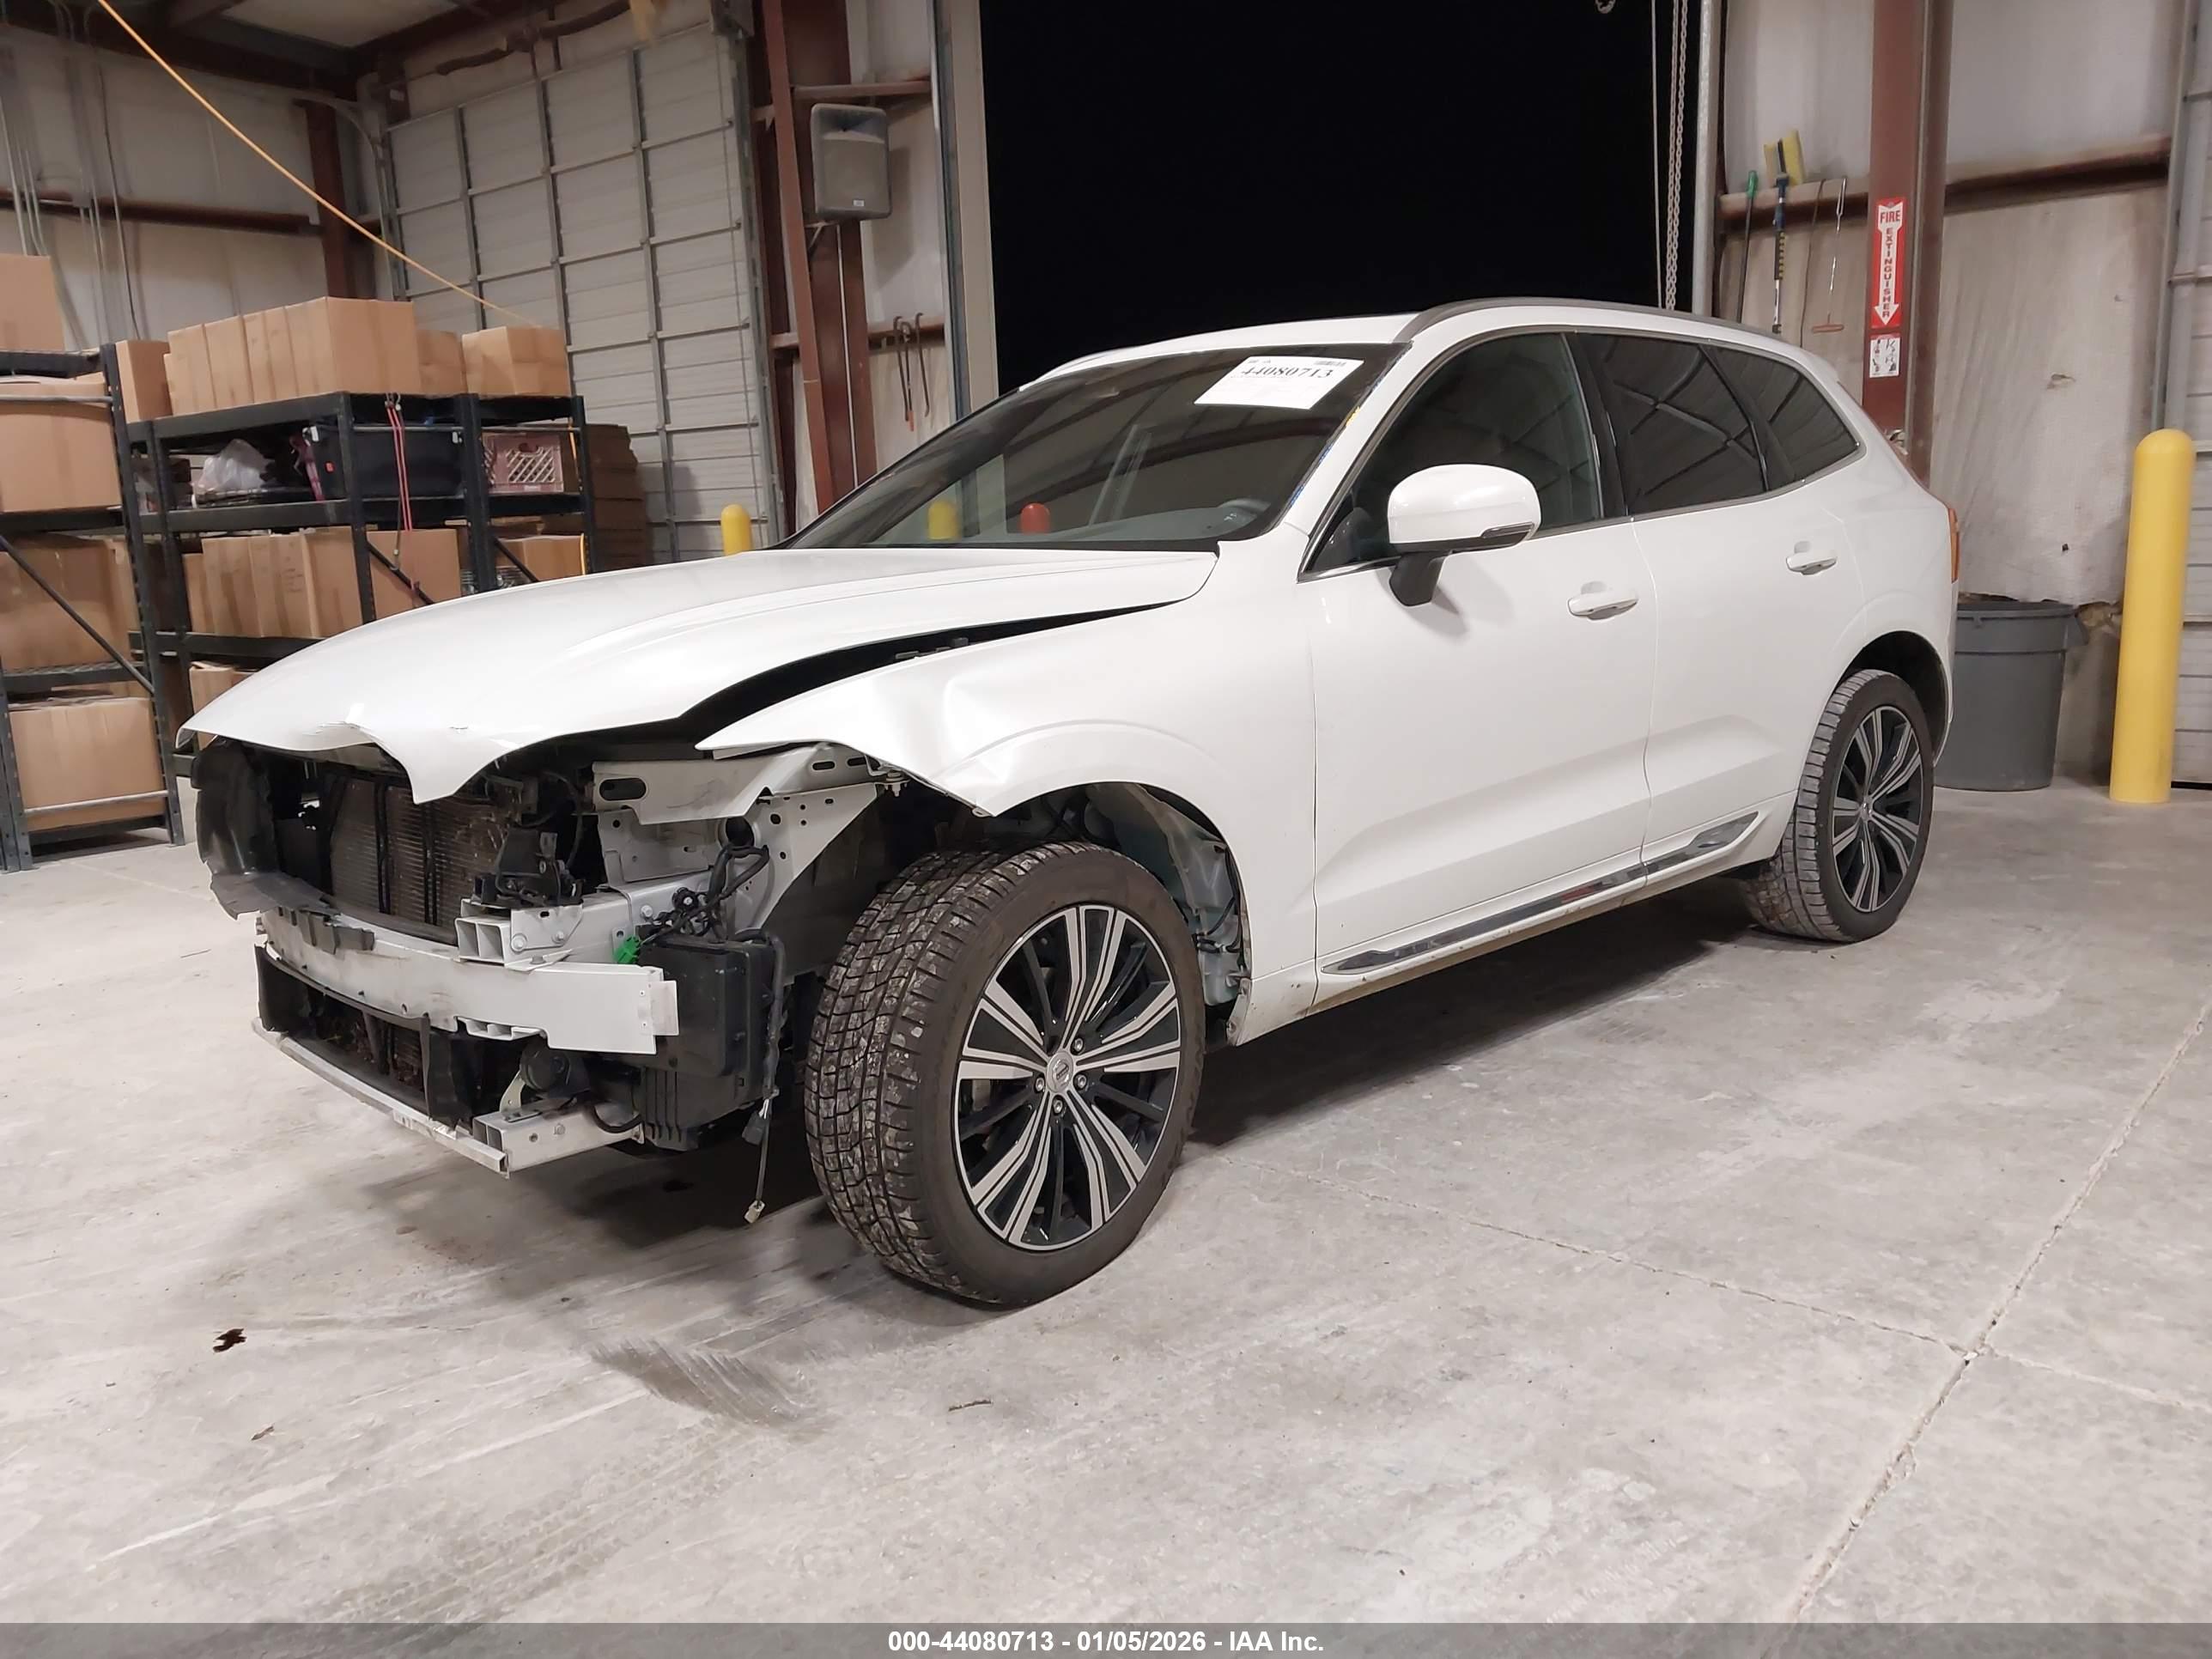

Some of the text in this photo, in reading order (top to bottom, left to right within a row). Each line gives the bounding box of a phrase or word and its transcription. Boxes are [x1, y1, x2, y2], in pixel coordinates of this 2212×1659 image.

[1880, 210, 1901, 223] FIRE
[1882, 228, 1893, 318] EXTINGUISHER
[1243, 367, 1334, 378] 44080713
